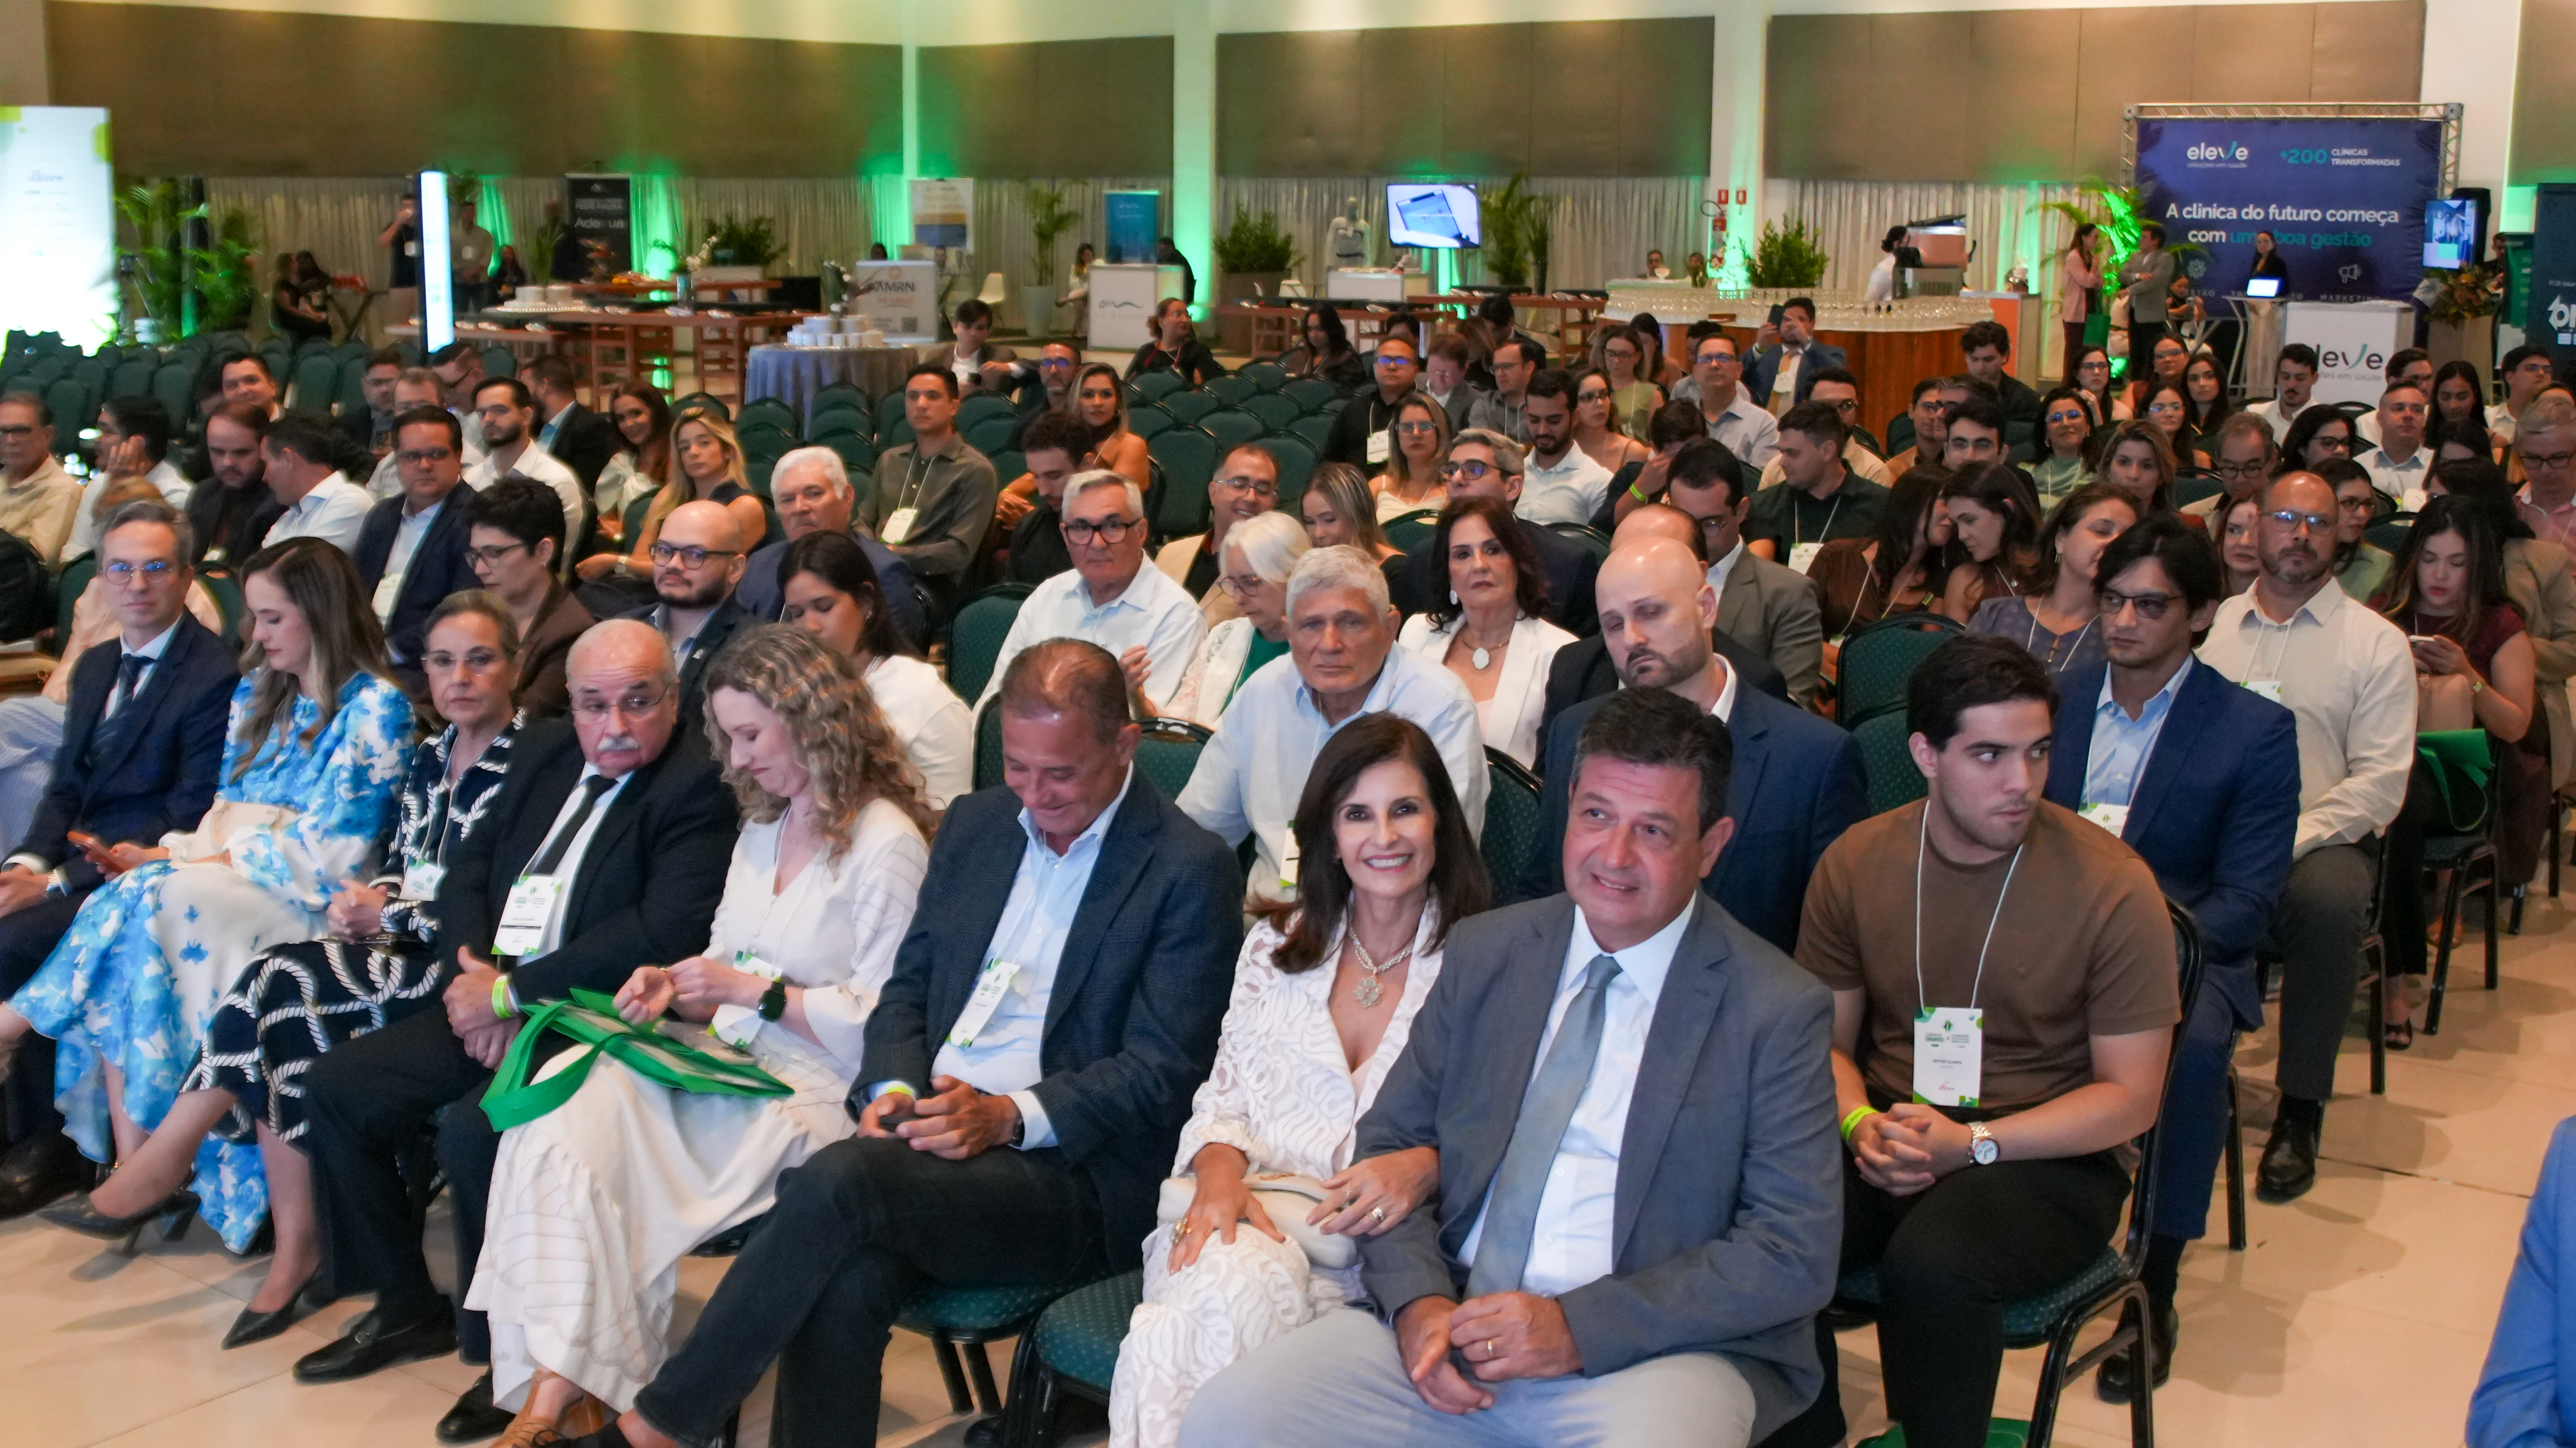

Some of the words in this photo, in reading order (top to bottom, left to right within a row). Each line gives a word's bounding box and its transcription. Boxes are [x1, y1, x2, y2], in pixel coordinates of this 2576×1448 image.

[2187, 141, 2248, 161] eleve
[2280, 148, 2328, 164] +200
[2166, 203, 2179, 218] A
[2241, 204, 2264, 221] do
[2269, 204, 2322, 221] futuro
[2326, 208, 2399, 226] começa
[2188, 230, 2226, 243] com
[2231, 232, 2256, 243] um
[2274, 229, 2306, 245] boa
[2311, 231, 2372, 249] gestão
[2316, 344, 2383, 370] leve
